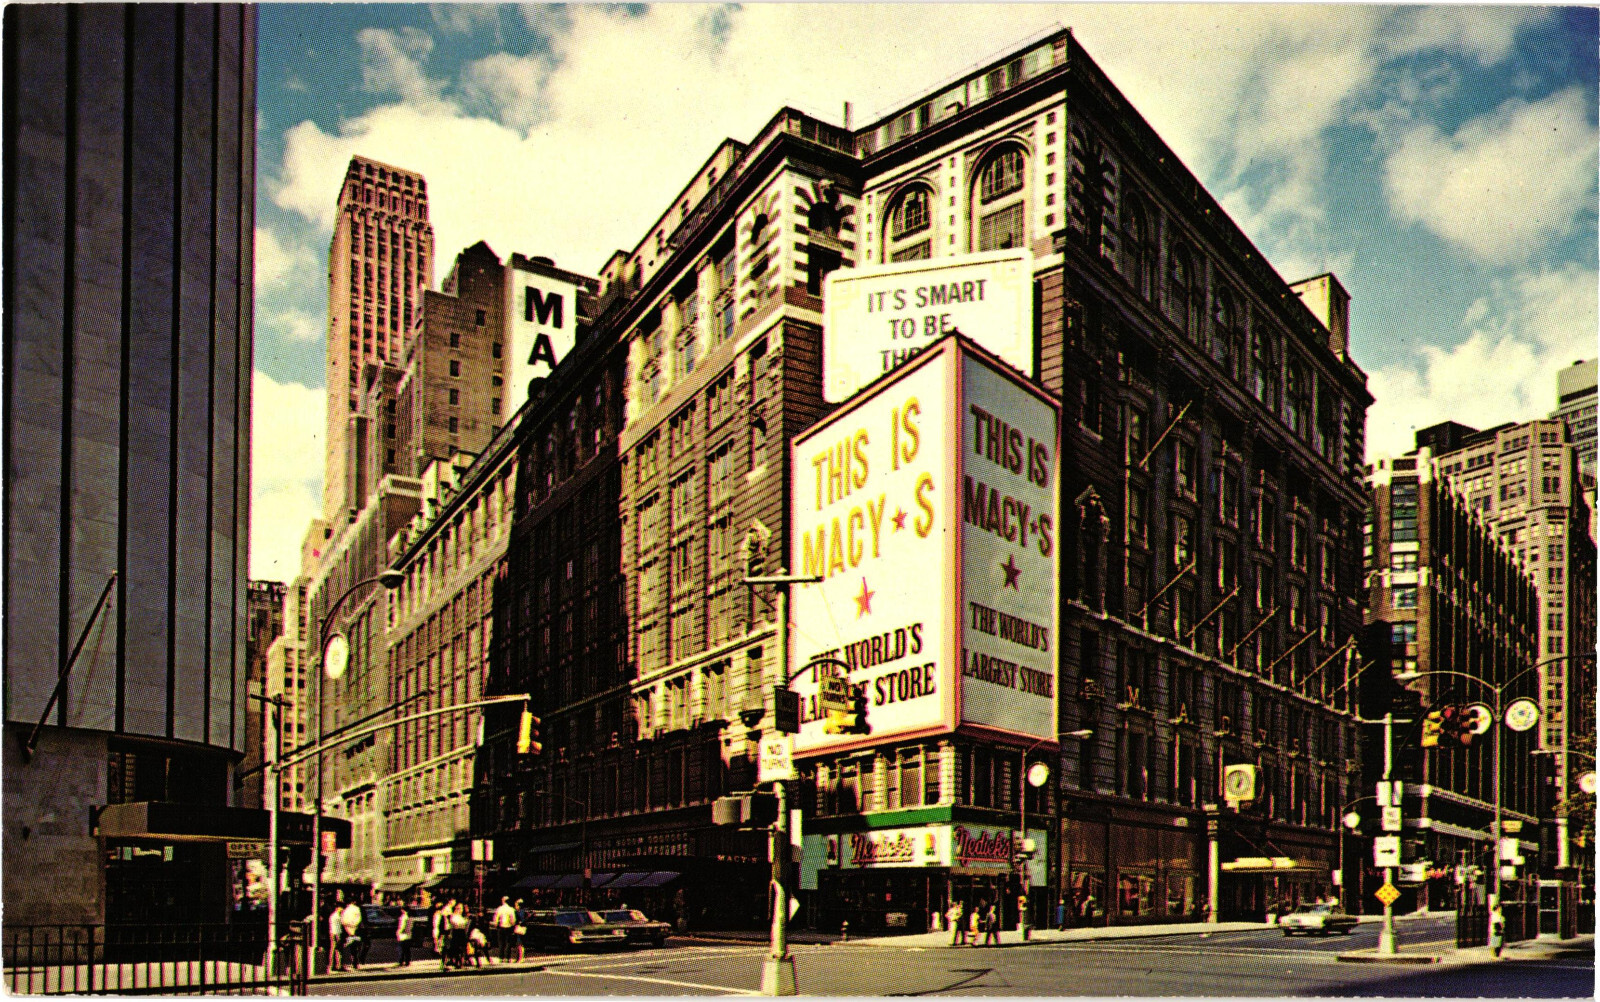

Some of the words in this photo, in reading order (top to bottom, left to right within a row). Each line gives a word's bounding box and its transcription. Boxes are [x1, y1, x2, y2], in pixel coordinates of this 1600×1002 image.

[867, 288, 907, 313] IT'S
[915, 278, 988, 310] SMART
[889, 317, 916, 340] TO
[923, 313, 952, 337] BE
[811, 428, 870, 511] THIS
[891, 396, 922, 472] IS
[970, 403, 1024, 475] THIS
[1027, 437, 1050, 489] IS
[970, 601, 997, 636] THE
[998, 611, 1050, 653] WORLD'S
[810, 647, 842, 684] THE
[845, 622, 923, 673] WORLD'S
[962, 648, 1018, 690] LARGEST
[1020, 664, 1054, 699] STORE
[875, 662, 937, 706] STORE
[767, 743, 783, 756] NO
